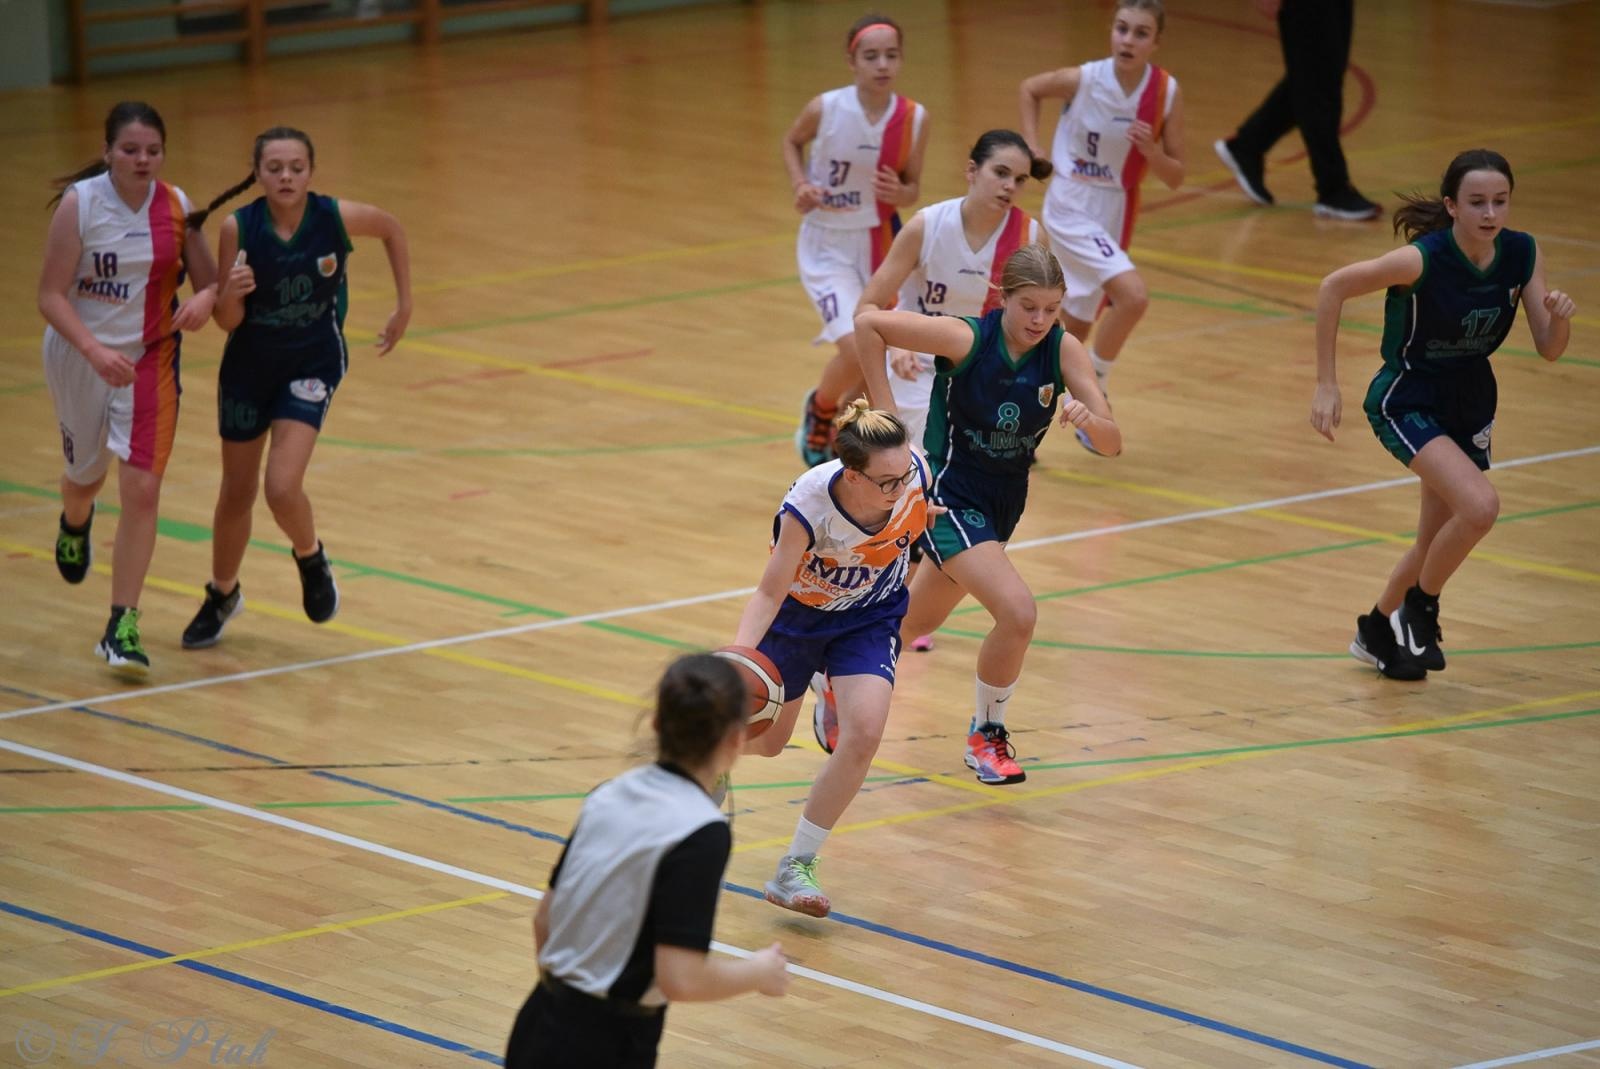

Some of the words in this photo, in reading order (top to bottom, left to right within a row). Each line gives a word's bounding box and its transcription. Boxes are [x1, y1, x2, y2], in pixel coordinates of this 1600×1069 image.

[828, 159, 851, 188] 27
[92, 251, 118, 279] 18
[78, 278, 130, 300] MINI
[273, 274, 313, 305] 10
[925, 280, 947, 305] 13
[1461, 306, 1501, 338] 17
[996, 401, 1021, 434] 8
